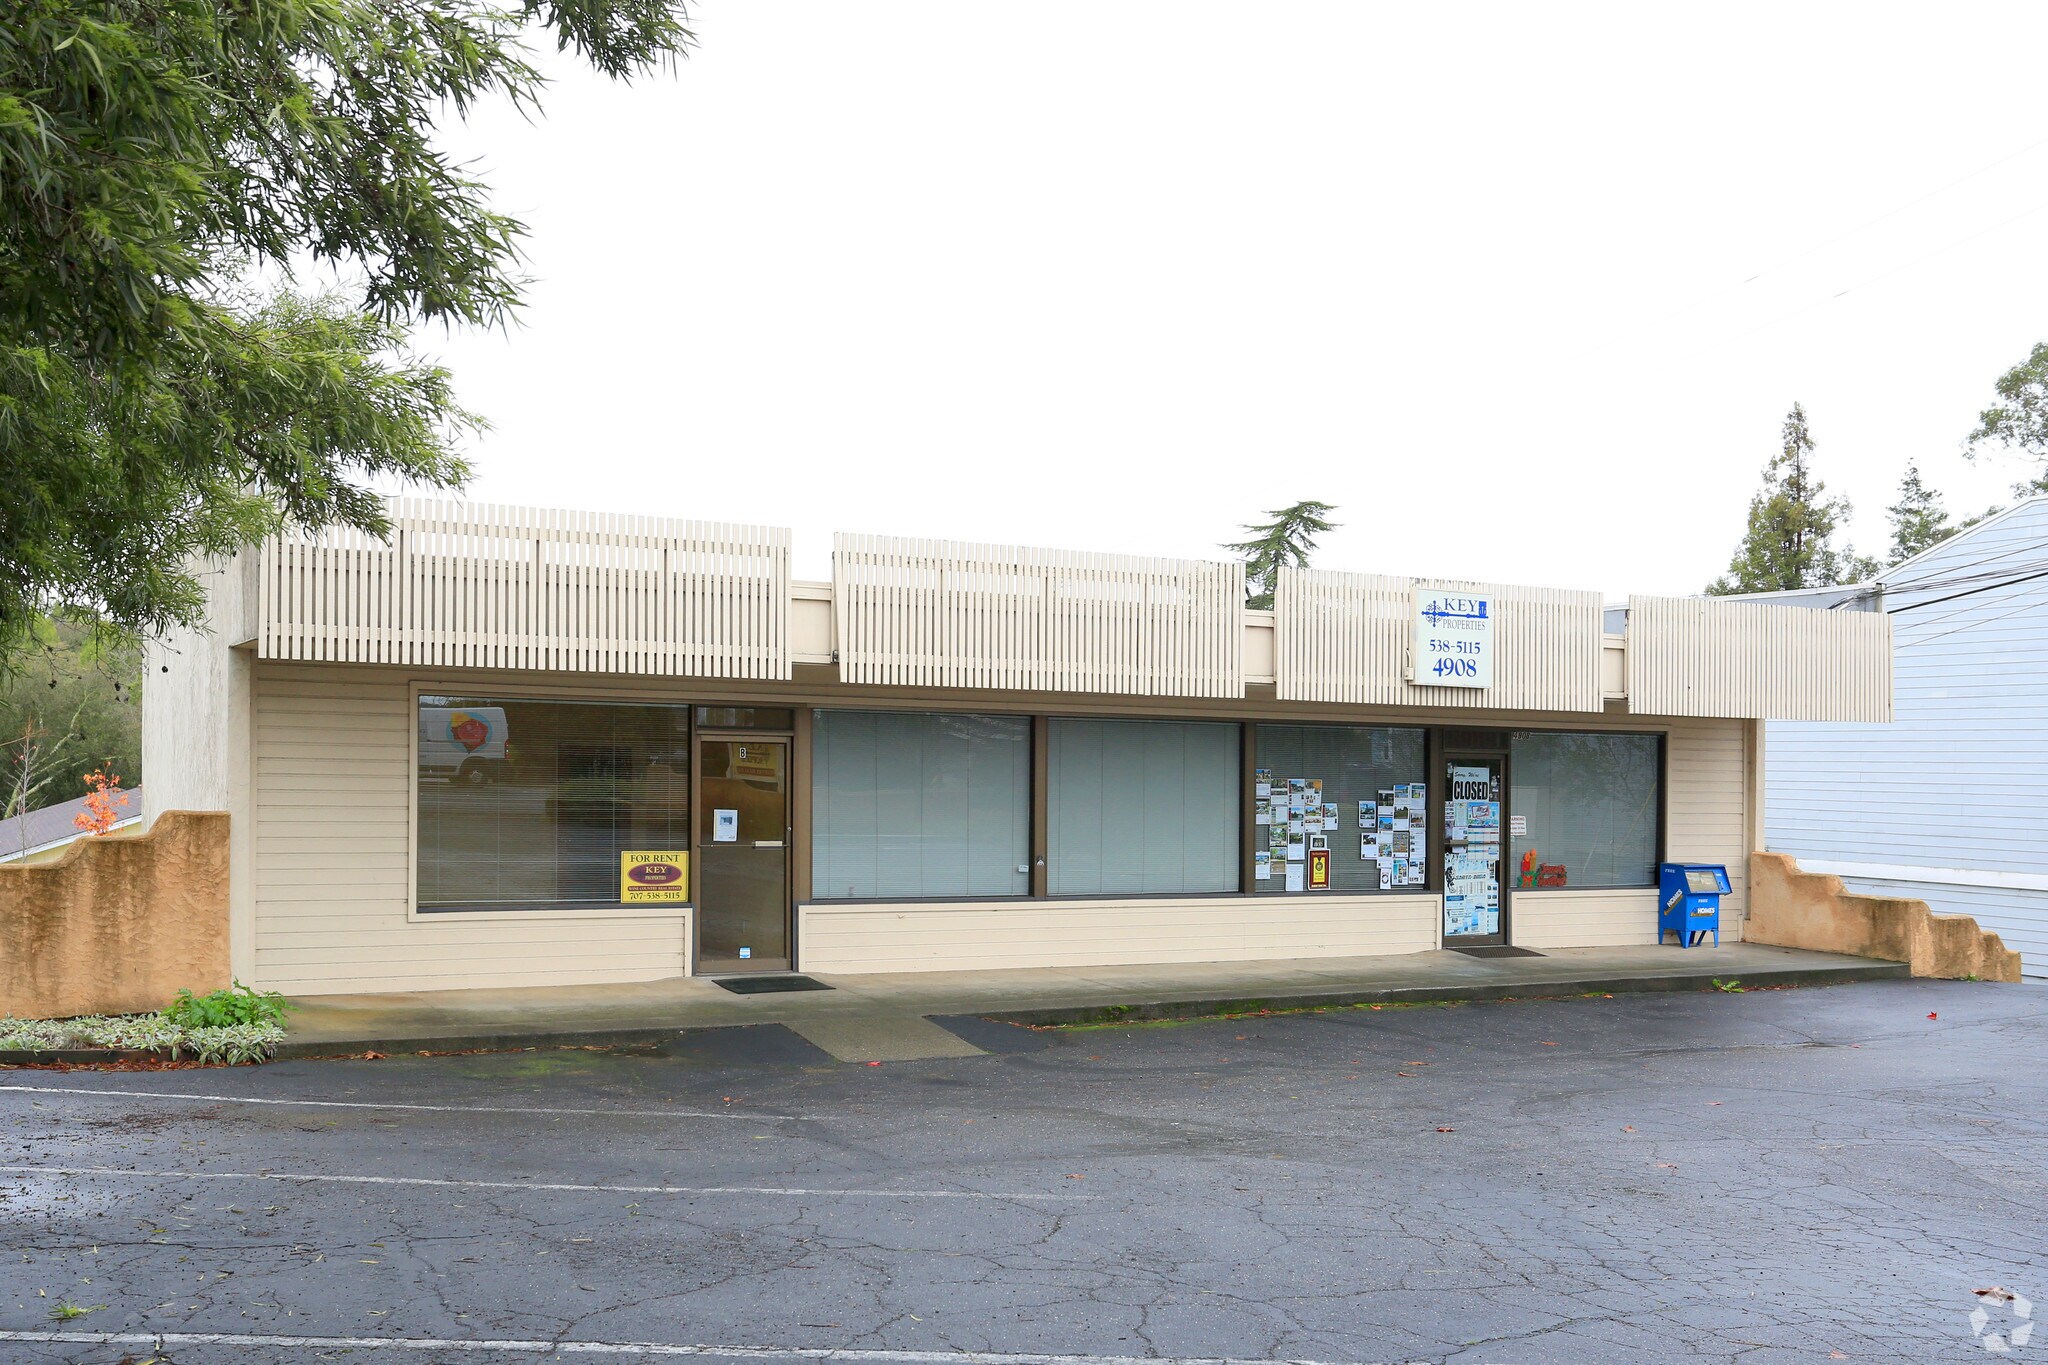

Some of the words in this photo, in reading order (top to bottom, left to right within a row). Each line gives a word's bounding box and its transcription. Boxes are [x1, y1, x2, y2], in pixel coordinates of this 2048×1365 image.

[1444, 598, 1477, 612] KEY
[1442, 618, 1486, 630] PROPERTIES
[1429, 639, 1481, 654] 538-5115
[1432, 657, 1477, 677] 4908
[740, 748, 746, 758] B
[1454, 780, 1488, 800] CLOSED
[630, 854, 650, 862] FOR
[653, 854, 680, 862] RENT
[645, 866, 667, 874] KEY
[629, 892, 680, 900] 707-538-5115
[1667, 888, 1683, 908] HOMES
